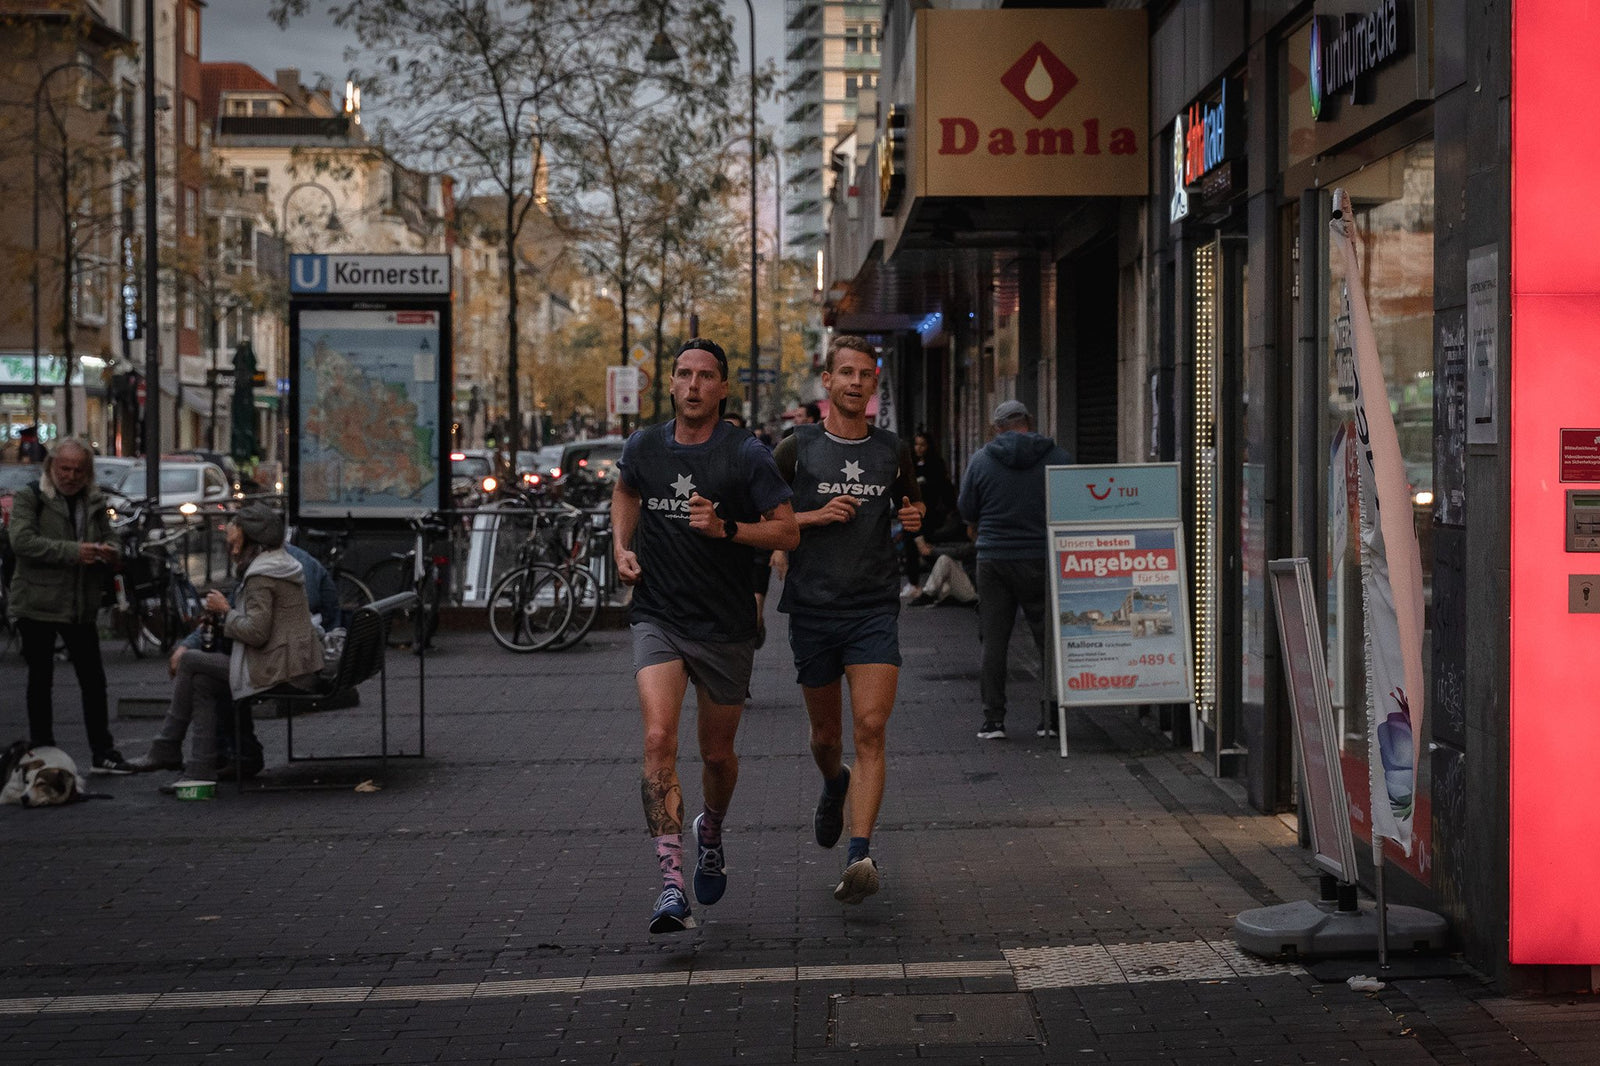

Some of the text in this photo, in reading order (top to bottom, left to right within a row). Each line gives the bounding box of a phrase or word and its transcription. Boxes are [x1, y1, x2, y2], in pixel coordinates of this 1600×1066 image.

[937, 117, 1139, 156] Damla
[294, 257, 443, 289] U Körnerstr.
[816, 482, 887, 497] SAYSKY
[1117, 487, 1139, 498] TUI
[647, 497, 721, 513] SAYS
[1059, 537, 1131, 549] Unsere besten
[1064, 551, 1170, 577] Angebote
[1137, 573, 1171, 584] für Sie
[1067, 640, 1104, 650] Mallorca
[1138, 653, 1165, 667] 489
[1168, 652, 1177, 666] €
[1067, 671, 1139, 691] alltours
